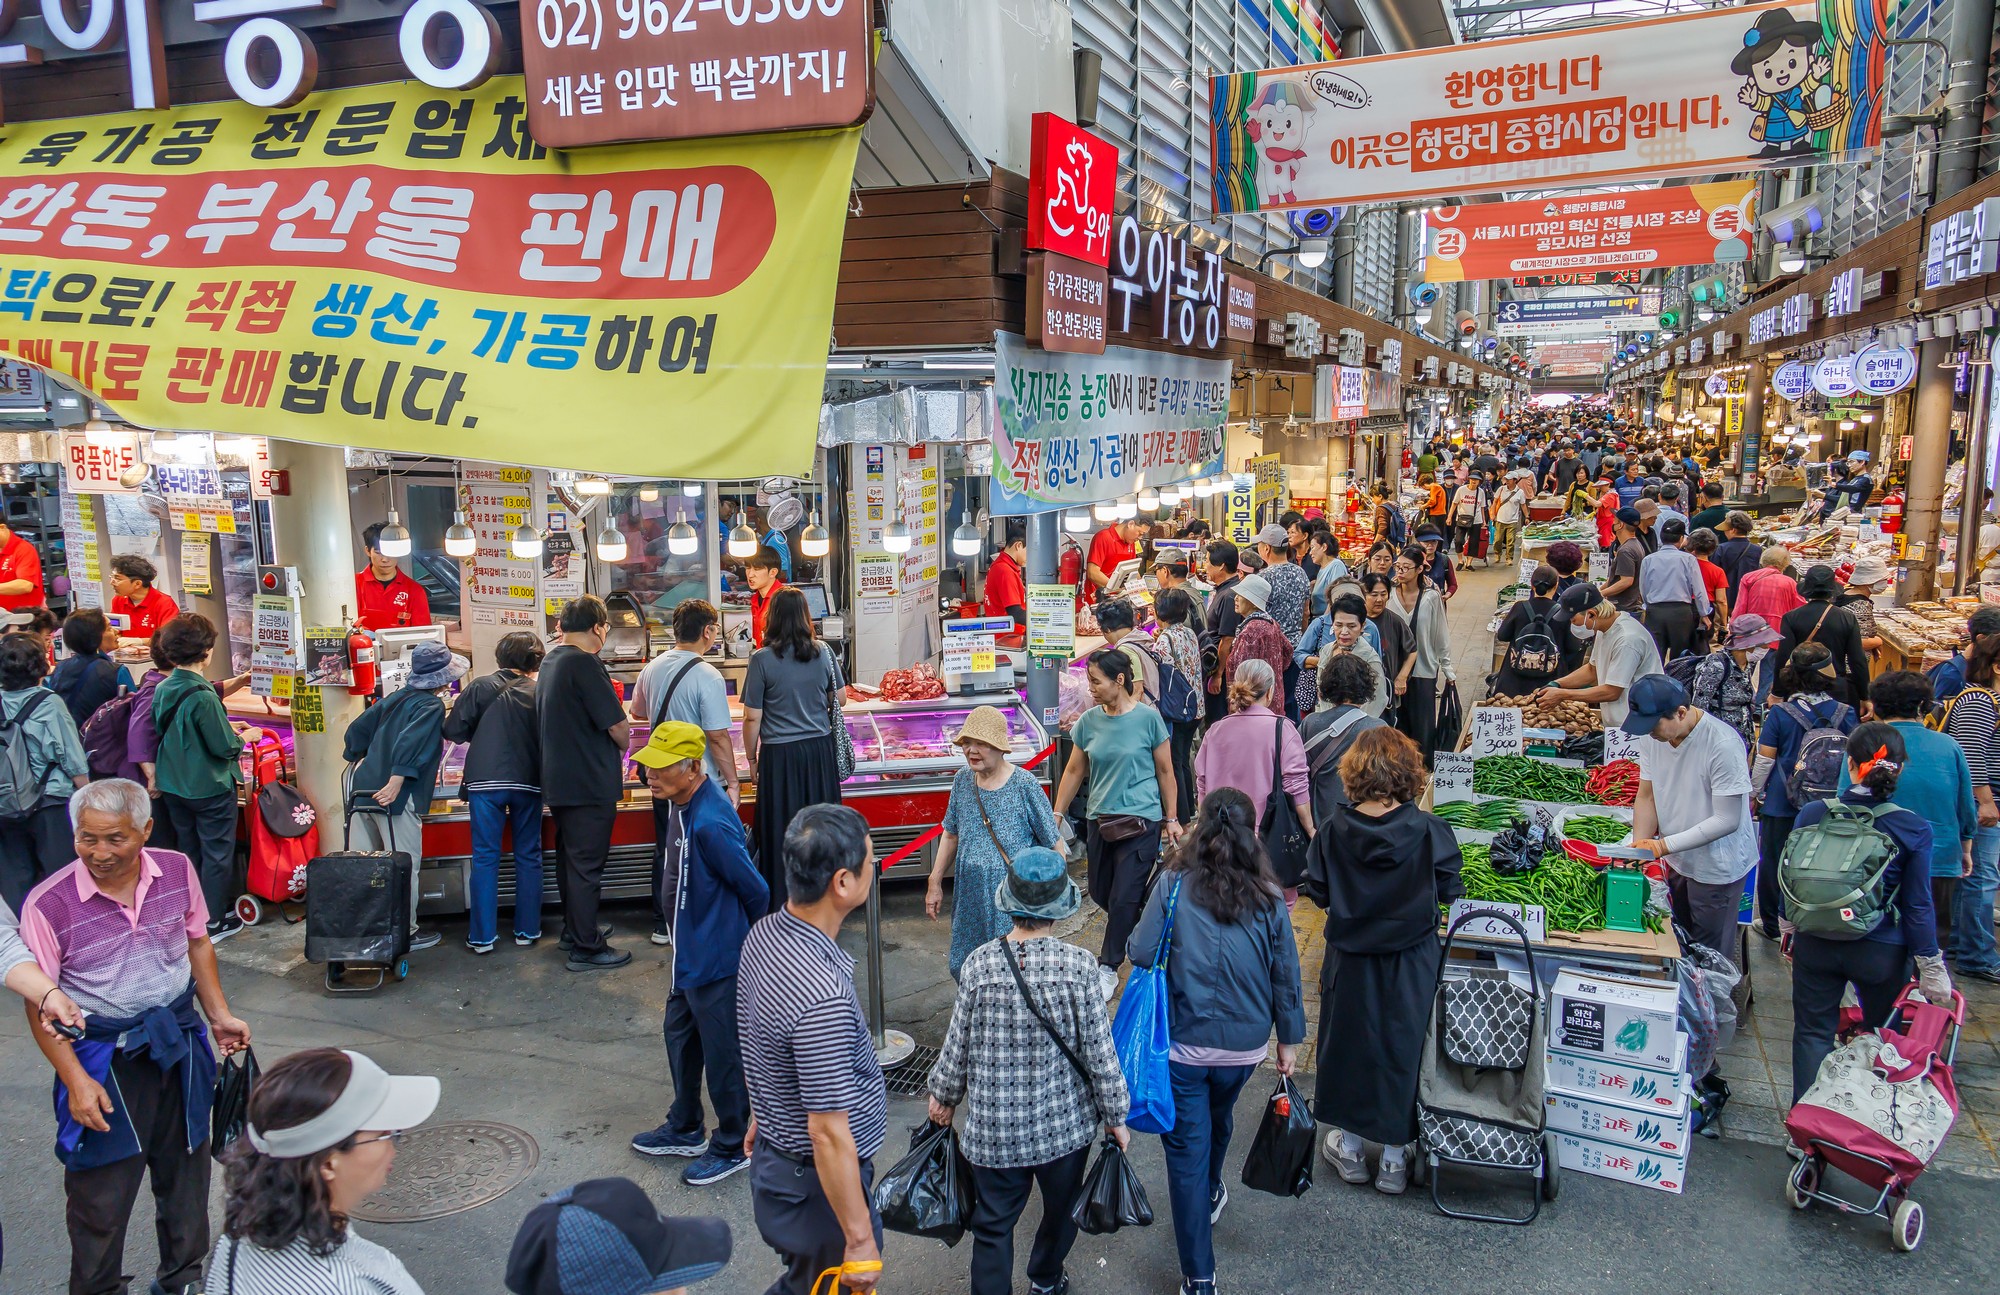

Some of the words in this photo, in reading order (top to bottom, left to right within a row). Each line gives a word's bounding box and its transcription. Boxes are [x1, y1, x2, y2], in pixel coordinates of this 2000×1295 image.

[542, 73, 605, 118] 세살
[615, 63, 679, 112] 입맛
[690, 50, 848, 102] 백살까지!
[1315, 77, 1358, 104] 안녕하세요!
[1444, 55, 1602, 109] 환영합니다
[20, 118, 222, 167] 육가공
[250, 98, 549, 161] 전문업체
[1330, 131, 1411, 169] 이곳은
[1415, 120, 1498, 163] 청량리
[1562, 201, 1590, 213] 청량리
[1591, 199, 1626, 212] 종합시장
[1084, 207, 1110, 257] 우아
[1472, 224, 1516, 241] 서울시
[1520, 218, 1565, 237] 디자인
[1568, 215, 1599, 233] 혁신
[1603, 211, 1666, 231] 전통시장
[1670, 208, 1702, 225] 조성
[1714, 209, 1741, 234] 축
[519, 184, 724, 283] 판매
[1439, 229, 1466, 255] 경
[1536, 233, 1597, 252] 공모사업
[1600, 230, 1631, 247] 선정
[1555, 256, 1587, 268] 시장으로
[1047, 270, 1103, 306] 육가공전문업체
[1112, 215, 1225, 350] 우아농장
[0, 269, 175, 327] 탁으로!
[186, 280, 296, 334] 직접
[311, 283, 447, 355] 생산,
[471, 308, 718, 374] 가공하여
[1866, 358, 1903, 371] 슬애네
[166, 346, 478, 428] 판매합니다.
[1079, 373, 1133, 419] 농장에서
[1137, 377, 1157, 416] 바로
[1159, 378, 1189, 416] 우리집
[1193, 381, 1226, 418] 식탁으로
[505, 498, 531, 508] 13,000
[861, 565, 893, 576] 환급행사
[861, 575, 893, 586] 참여점포
[509, 587, 535, 597] 10,000
[259, 614, 289, 628] 환급행사
[258, 628, 289, 641] 참여점포
[1486, 739, 1517, 754] 3000
[1447, 764, 1473, 776] 4000
[1566, 1016, 1602, 1030] 꽈리고추
[1573, 1008, 1592, 1018] 화천
[1655, 1054, 1670, 1063] 4kg
